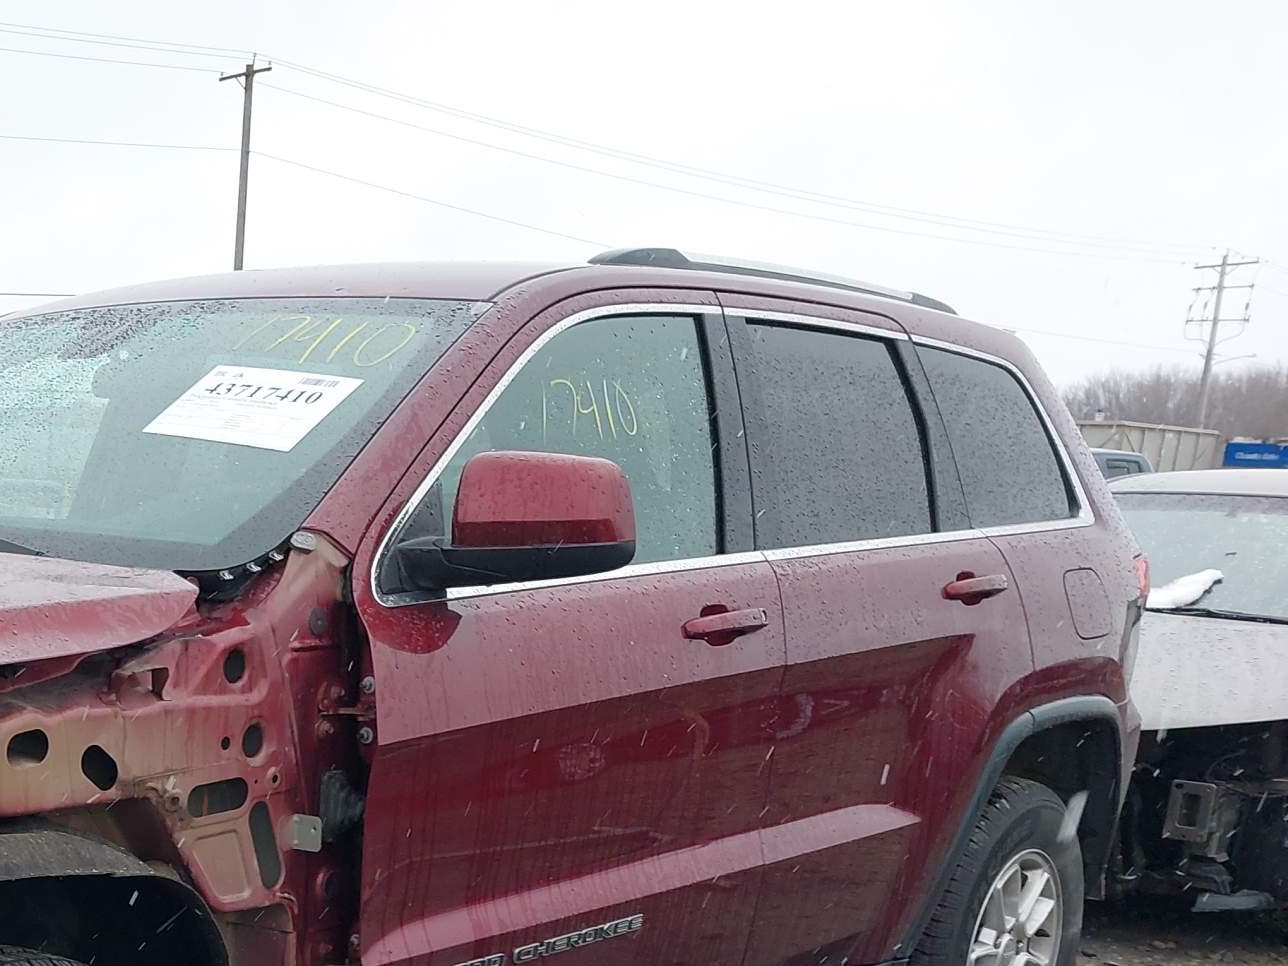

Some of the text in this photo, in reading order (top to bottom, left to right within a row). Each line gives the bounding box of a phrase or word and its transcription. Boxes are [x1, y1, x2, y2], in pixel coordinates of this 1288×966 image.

[204, 382, 324, 405] 43717410
[541, 378, 638, 444] 17410
[513, 913, 644, 964] CHEROKEE
